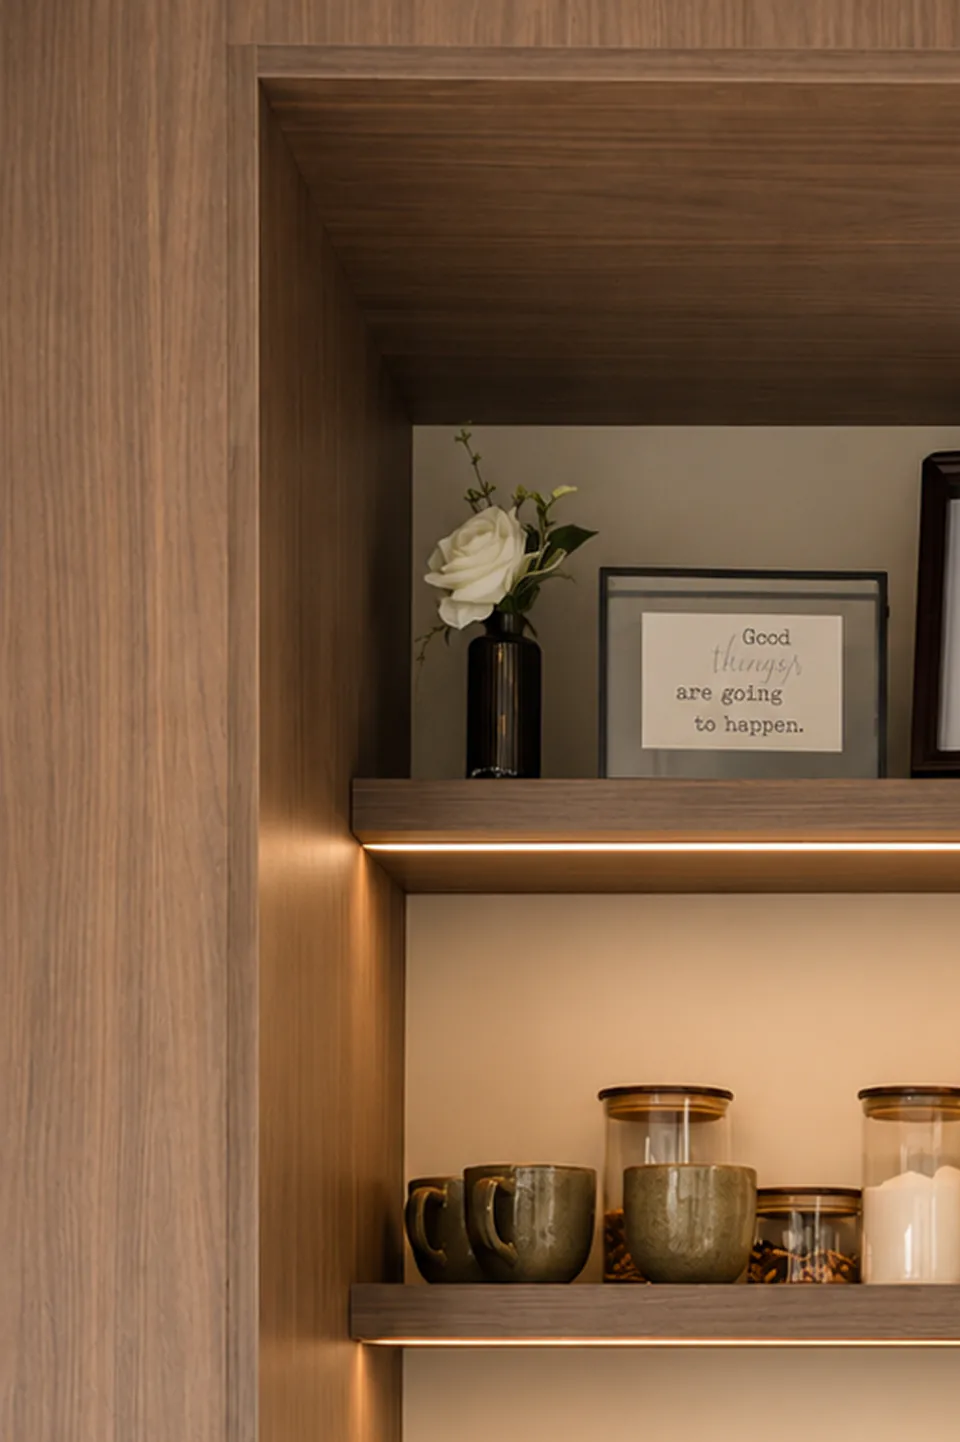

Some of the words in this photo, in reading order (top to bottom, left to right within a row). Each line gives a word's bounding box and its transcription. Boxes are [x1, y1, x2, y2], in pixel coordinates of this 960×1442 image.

[742, 628, 791, 646] Good
[676, 686, 712, 700] are
[721, 684, 783, 706] going
[694, 716, 716, 732] to
[724, 716, 804, 737] happen.
